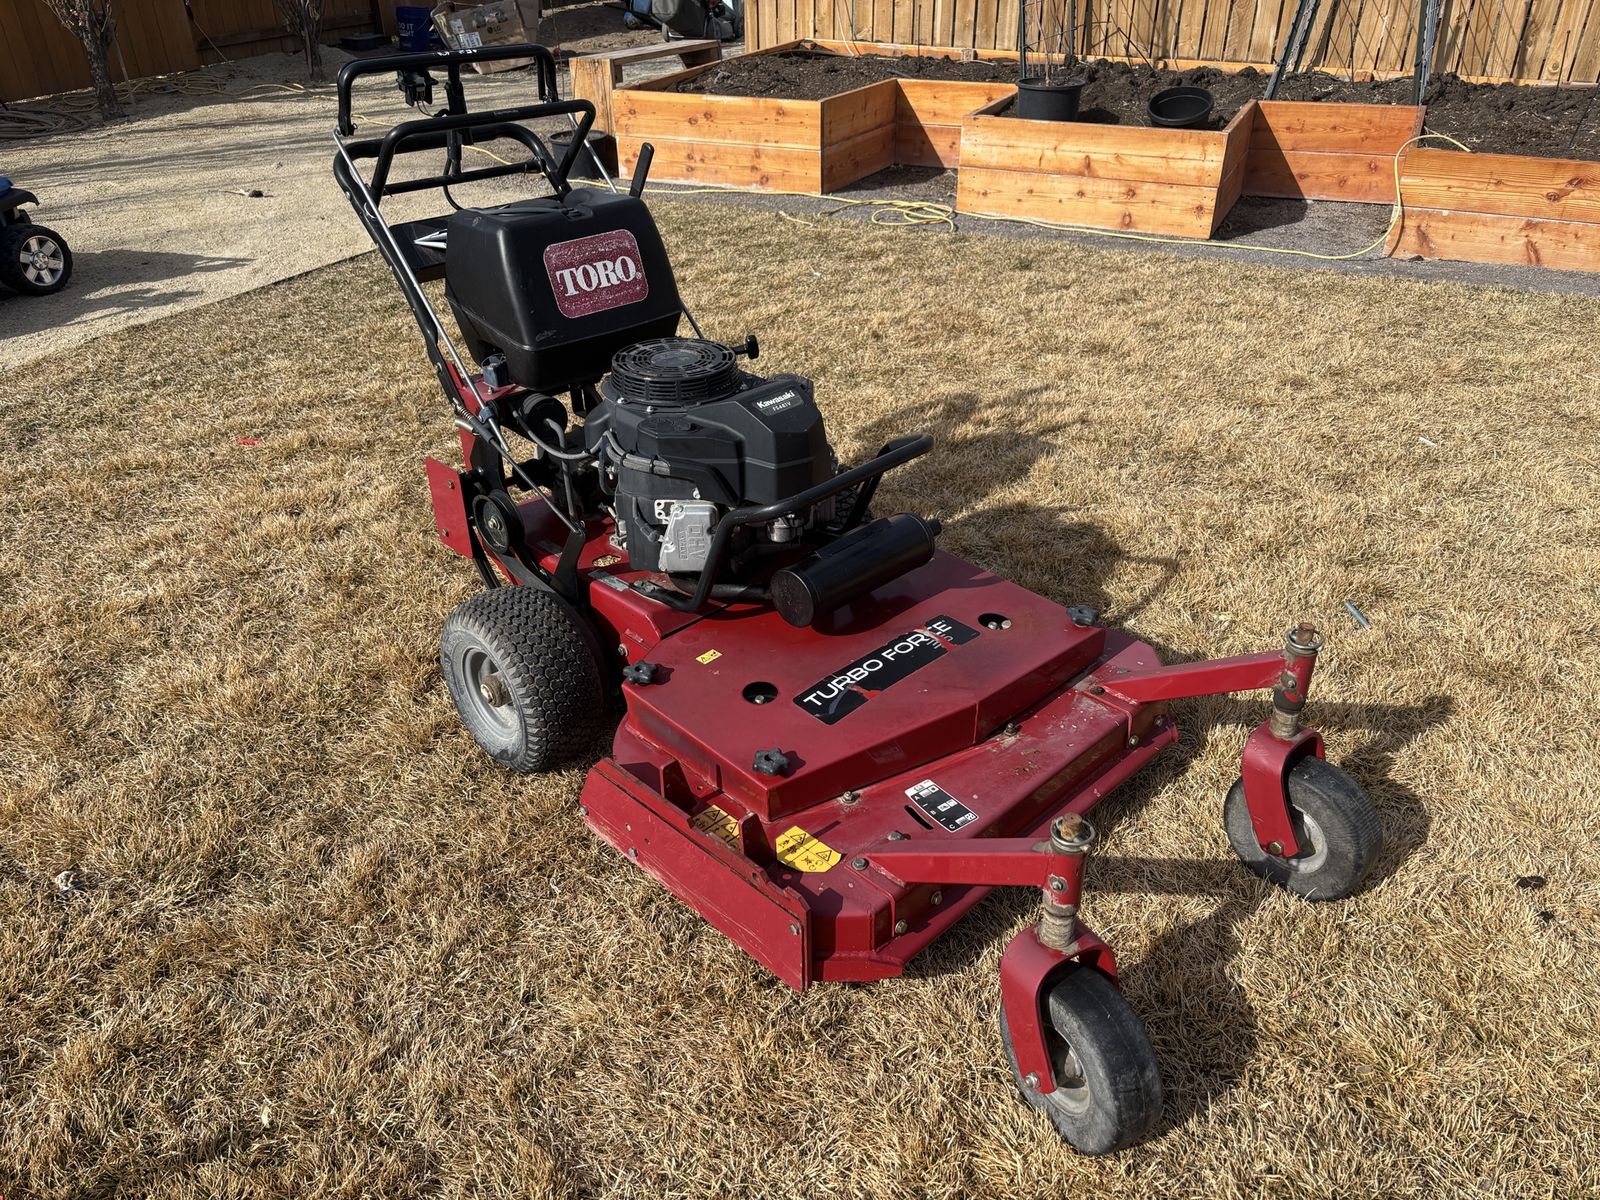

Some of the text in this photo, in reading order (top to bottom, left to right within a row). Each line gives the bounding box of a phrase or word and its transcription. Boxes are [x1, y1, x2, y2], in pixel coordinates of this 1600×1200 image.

[555, 256, 636, 297] TORO
[756, 390, 796, 409] Kawasaki
[803, 659, 884, 706] TURBO
